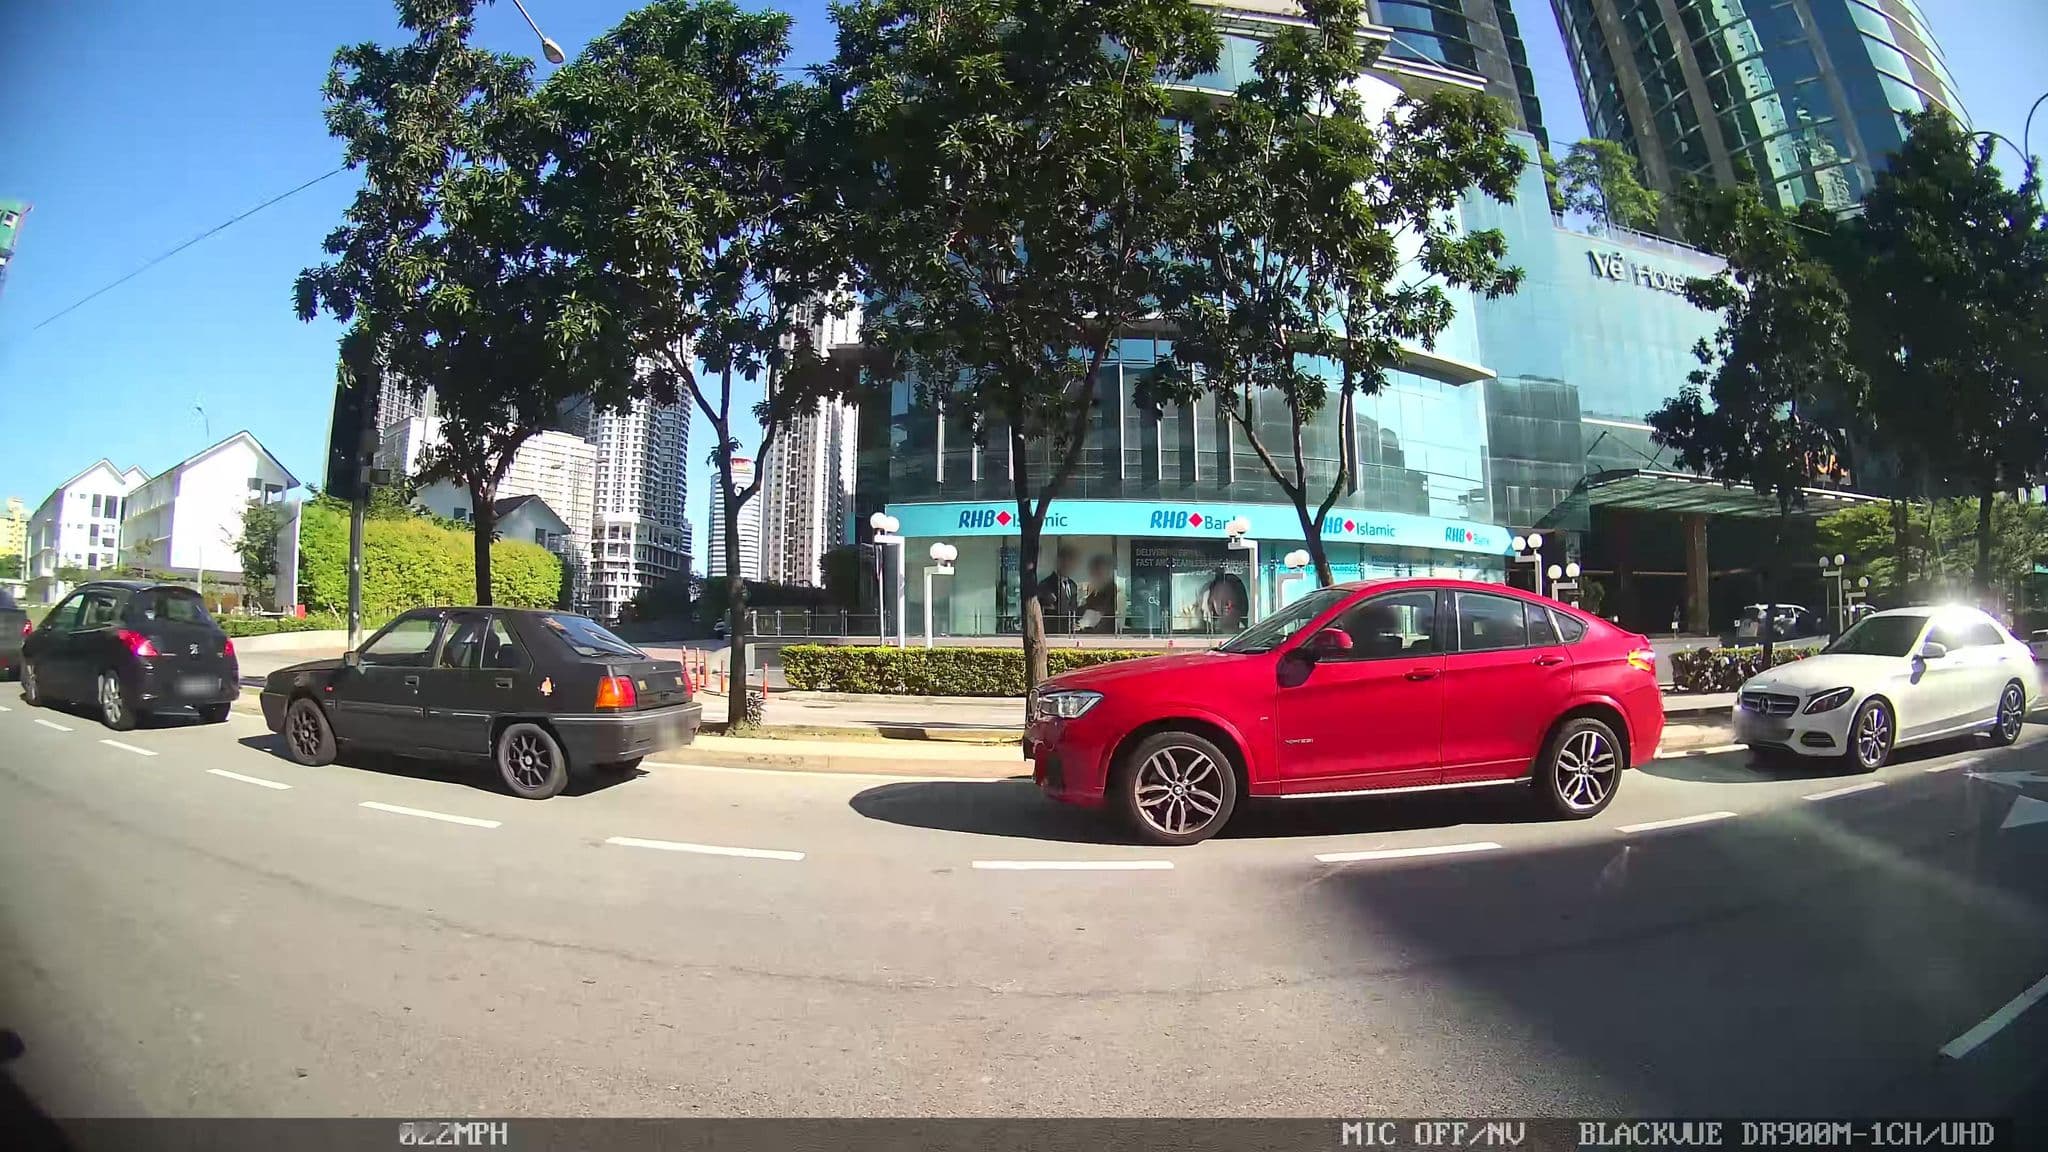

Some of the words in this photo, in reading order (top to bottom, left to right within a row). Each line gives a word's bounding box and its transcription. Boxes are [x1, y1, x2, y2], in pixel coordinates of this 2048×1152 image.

[959, 510, 997, 528] RHB
[1013, 513, 1068, 527] Imic
[1150, 511, 1188, 529] RHB
[1322, 516, 1343, 534] HB
[1357, 522, 1397, 537] Islamic
[1445, 526, 1466, 544] RHB
